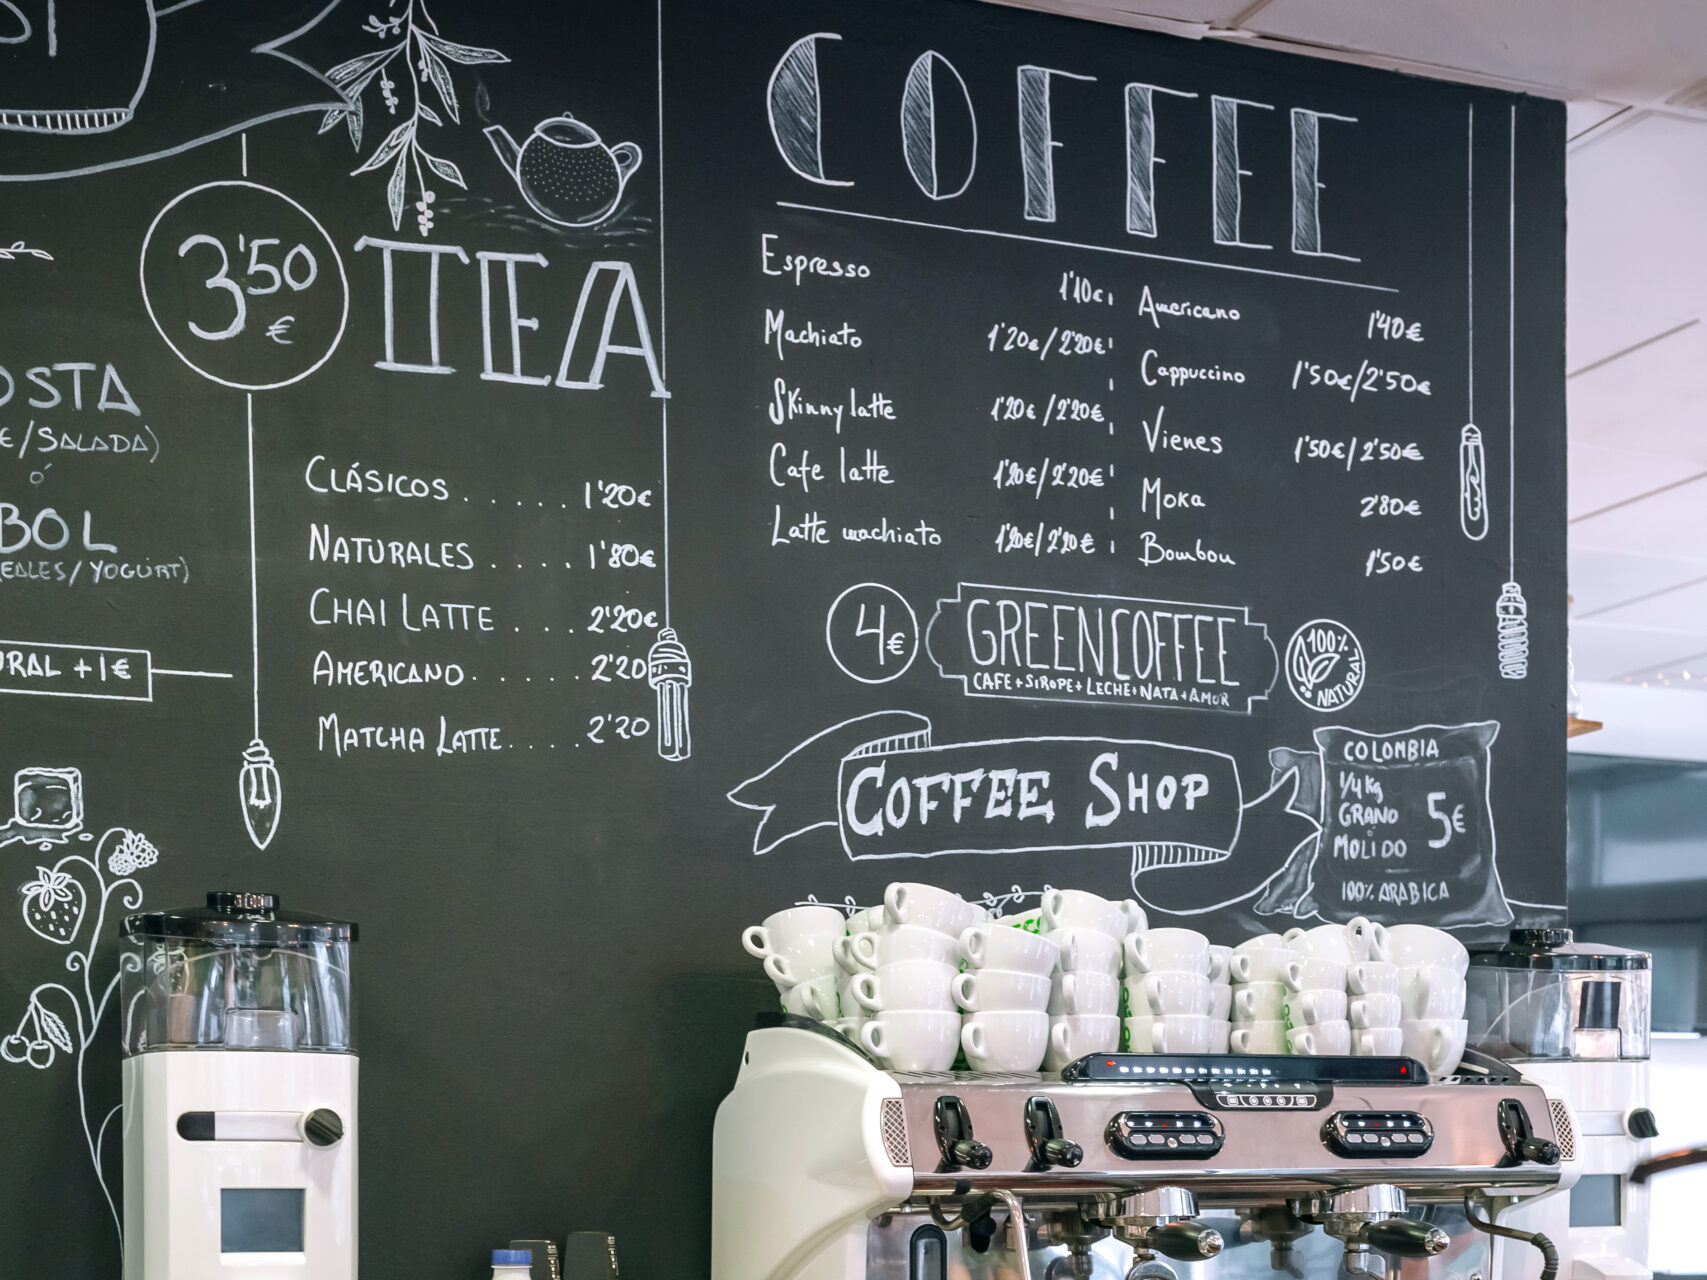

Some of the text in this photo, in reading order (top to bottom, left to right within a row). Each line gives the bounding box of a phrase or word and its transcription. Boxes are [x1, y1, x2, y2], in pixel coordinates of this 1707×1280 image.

[765, 32, 1365, 264] COFFEE
[761, 233, 871, 286] Espresso
[353, 233, 672, 401] TEA
[764, 308, 863, 361] Machiato
[1141, 349, 1246, 387] Cappuccino
[850, 387, 897, 420] latte
[1142, 405, 1223, 455] Vienes
[305, 454, 449, 501] CLÁSICOS
[769, 442, 895, 493] Cafe latte
[1141, 477, 1206, 520] Moka
[0, 502, 118, 554] BOL
[309, 523, 474, 570] NATURALES
[771, 504, 830, 547] Latte
[309, 587, 386, 627] CHAI
[402, 592, 495, 632] LATTE
[313, 650, 465, 688] AMERICANO
[1314, 646, 1363, 709] NATURAL
[318, 712, 425, 757] MATCHA
[436, 715, 502, 757] LATTE
[1343, 738, 1439, 763] COLOMBIA
[842, 749, 1213, 839] COFFEE SHOP
[1338, 799, 1399, 827] GRANO
[1333, 831, 1407, 861] MOLIDO
[1378, 881, 1450, 906] ARABICA
